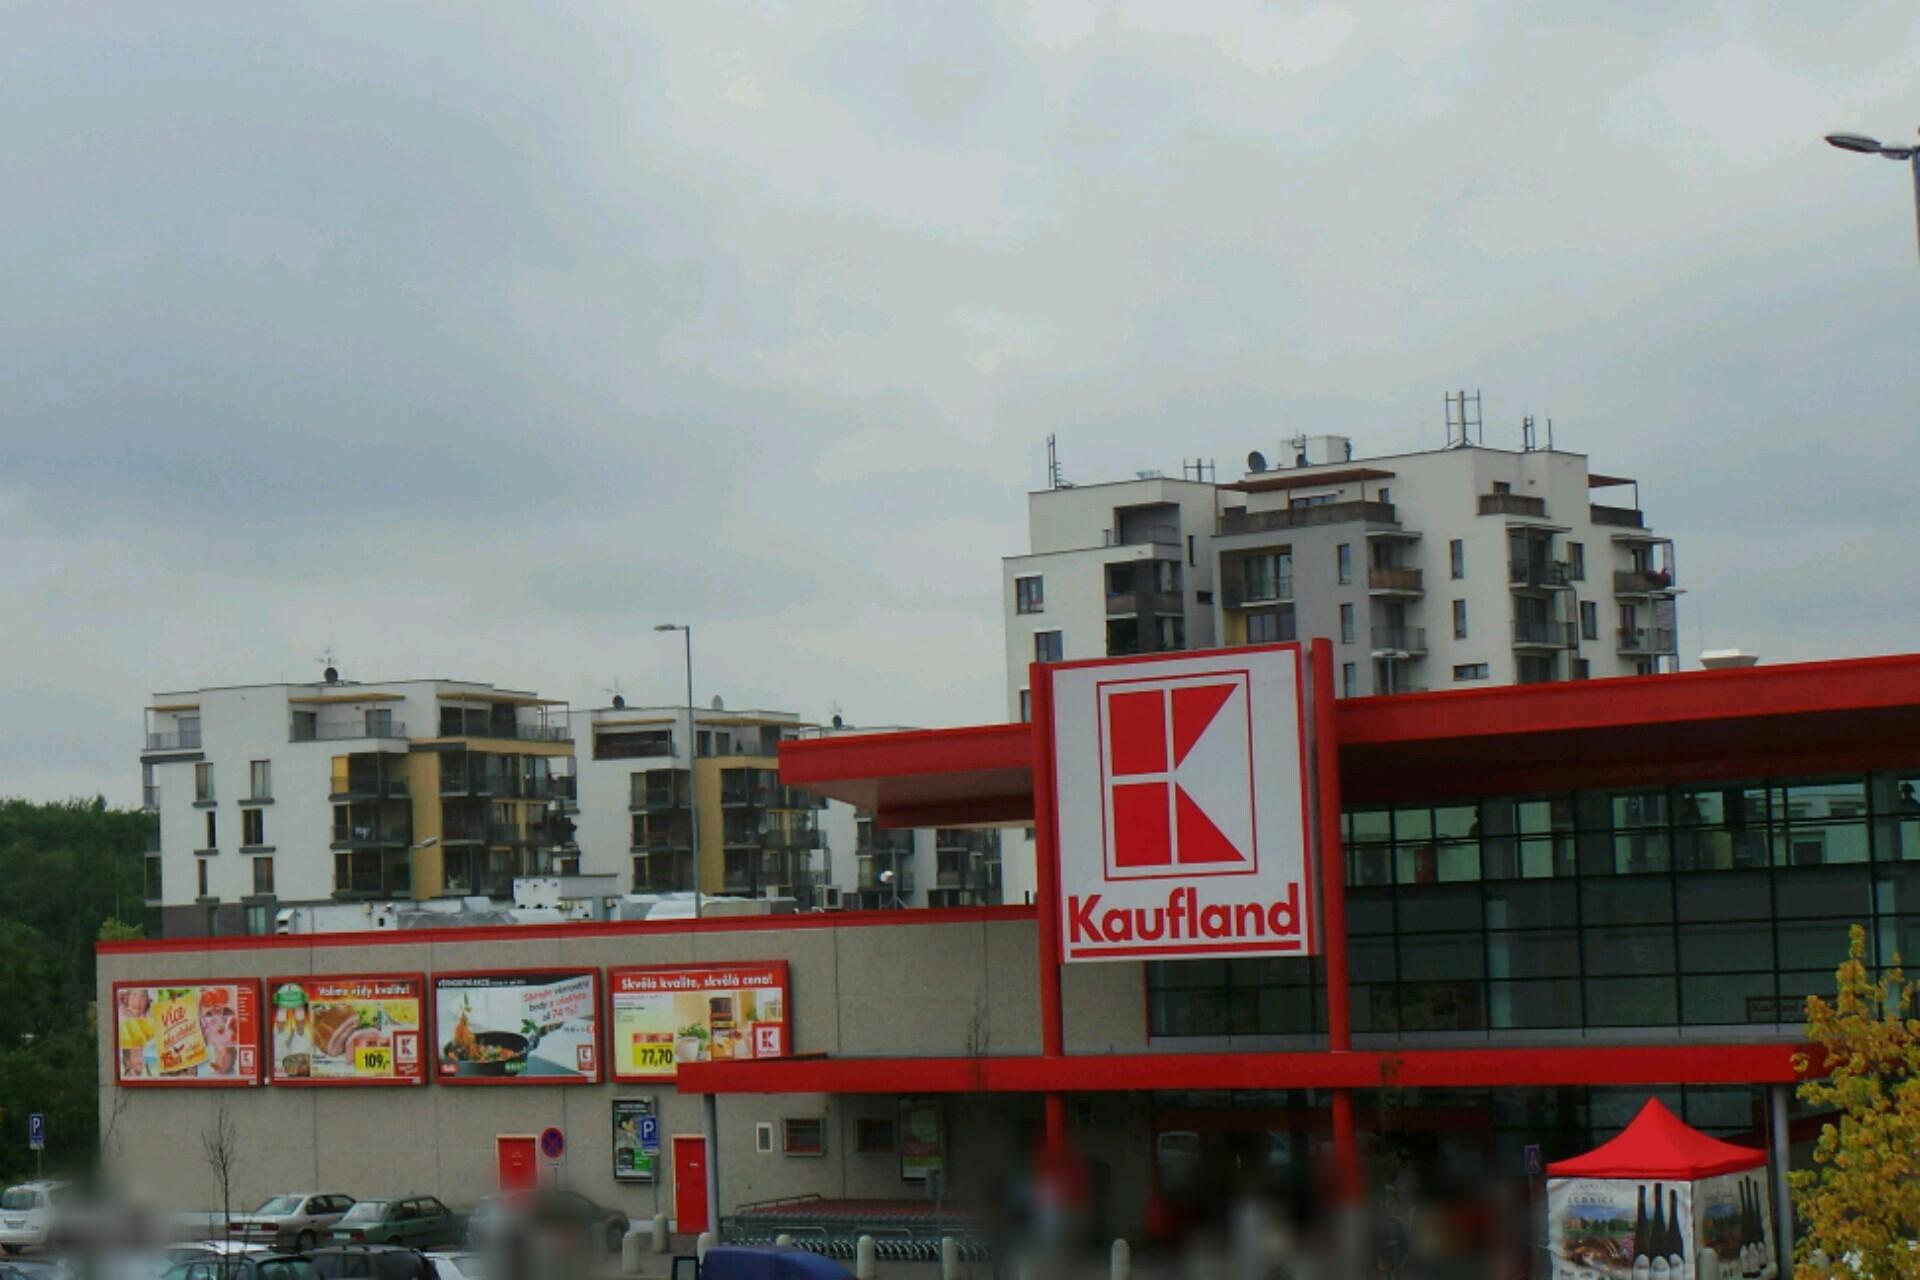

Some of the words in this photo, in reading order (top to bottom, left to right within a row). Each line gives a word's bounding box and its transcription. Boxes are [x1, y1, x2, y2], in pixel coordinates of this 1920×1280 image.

[1108, 682, 1247, 868] K
[1067, 882, 1301, 943] Kaufland
[621, 976, 657, 991] Skvělá
[659, 975, 701, 989] kvalita,
[704, 974, 740, 987] skvělá
[742, 973, 773, 986] cena!
[364, 1053, 390, 1070] 109,-
[640, 1048, 673, 1067] 77,70
[32, 1117, 41, 1133] P
[643, 1121, 655, 1138] P
